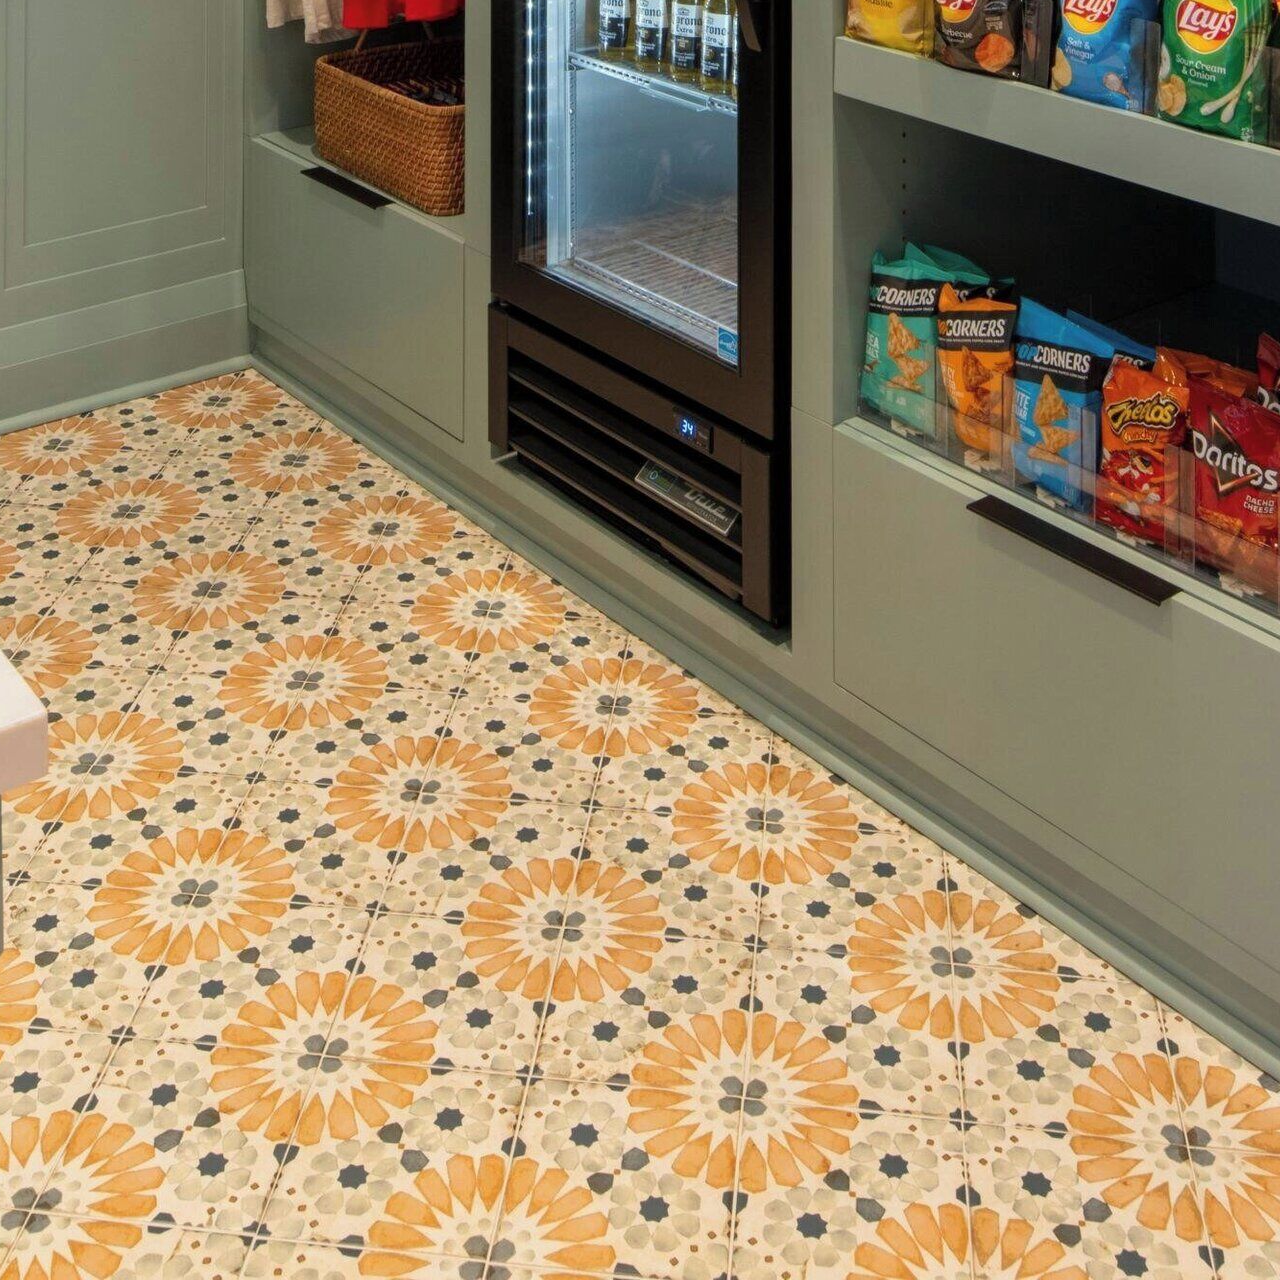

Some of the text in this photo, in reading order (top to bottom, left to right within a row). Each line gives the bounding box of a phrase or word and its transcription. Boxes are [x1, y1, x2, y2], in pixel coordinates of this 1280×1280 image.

[1178, 0, 1236, 41] Lay's
[1067, 37, 1091, 50] Salt &
[1065, 46, 1094, 60] Vinegar
[1175, 54, 1227, 75] Sour Cream
[1181, 67, 1216, 82] & Onion
[1107, 395, 1176, 432] Cheetos
[681, 419, 694, 436] 34
[1192, 429, 1279, 491] Doritos
[1243, 501, 1275, 514] CHEESE
[1245, 494, 1275, 507] NACHO
